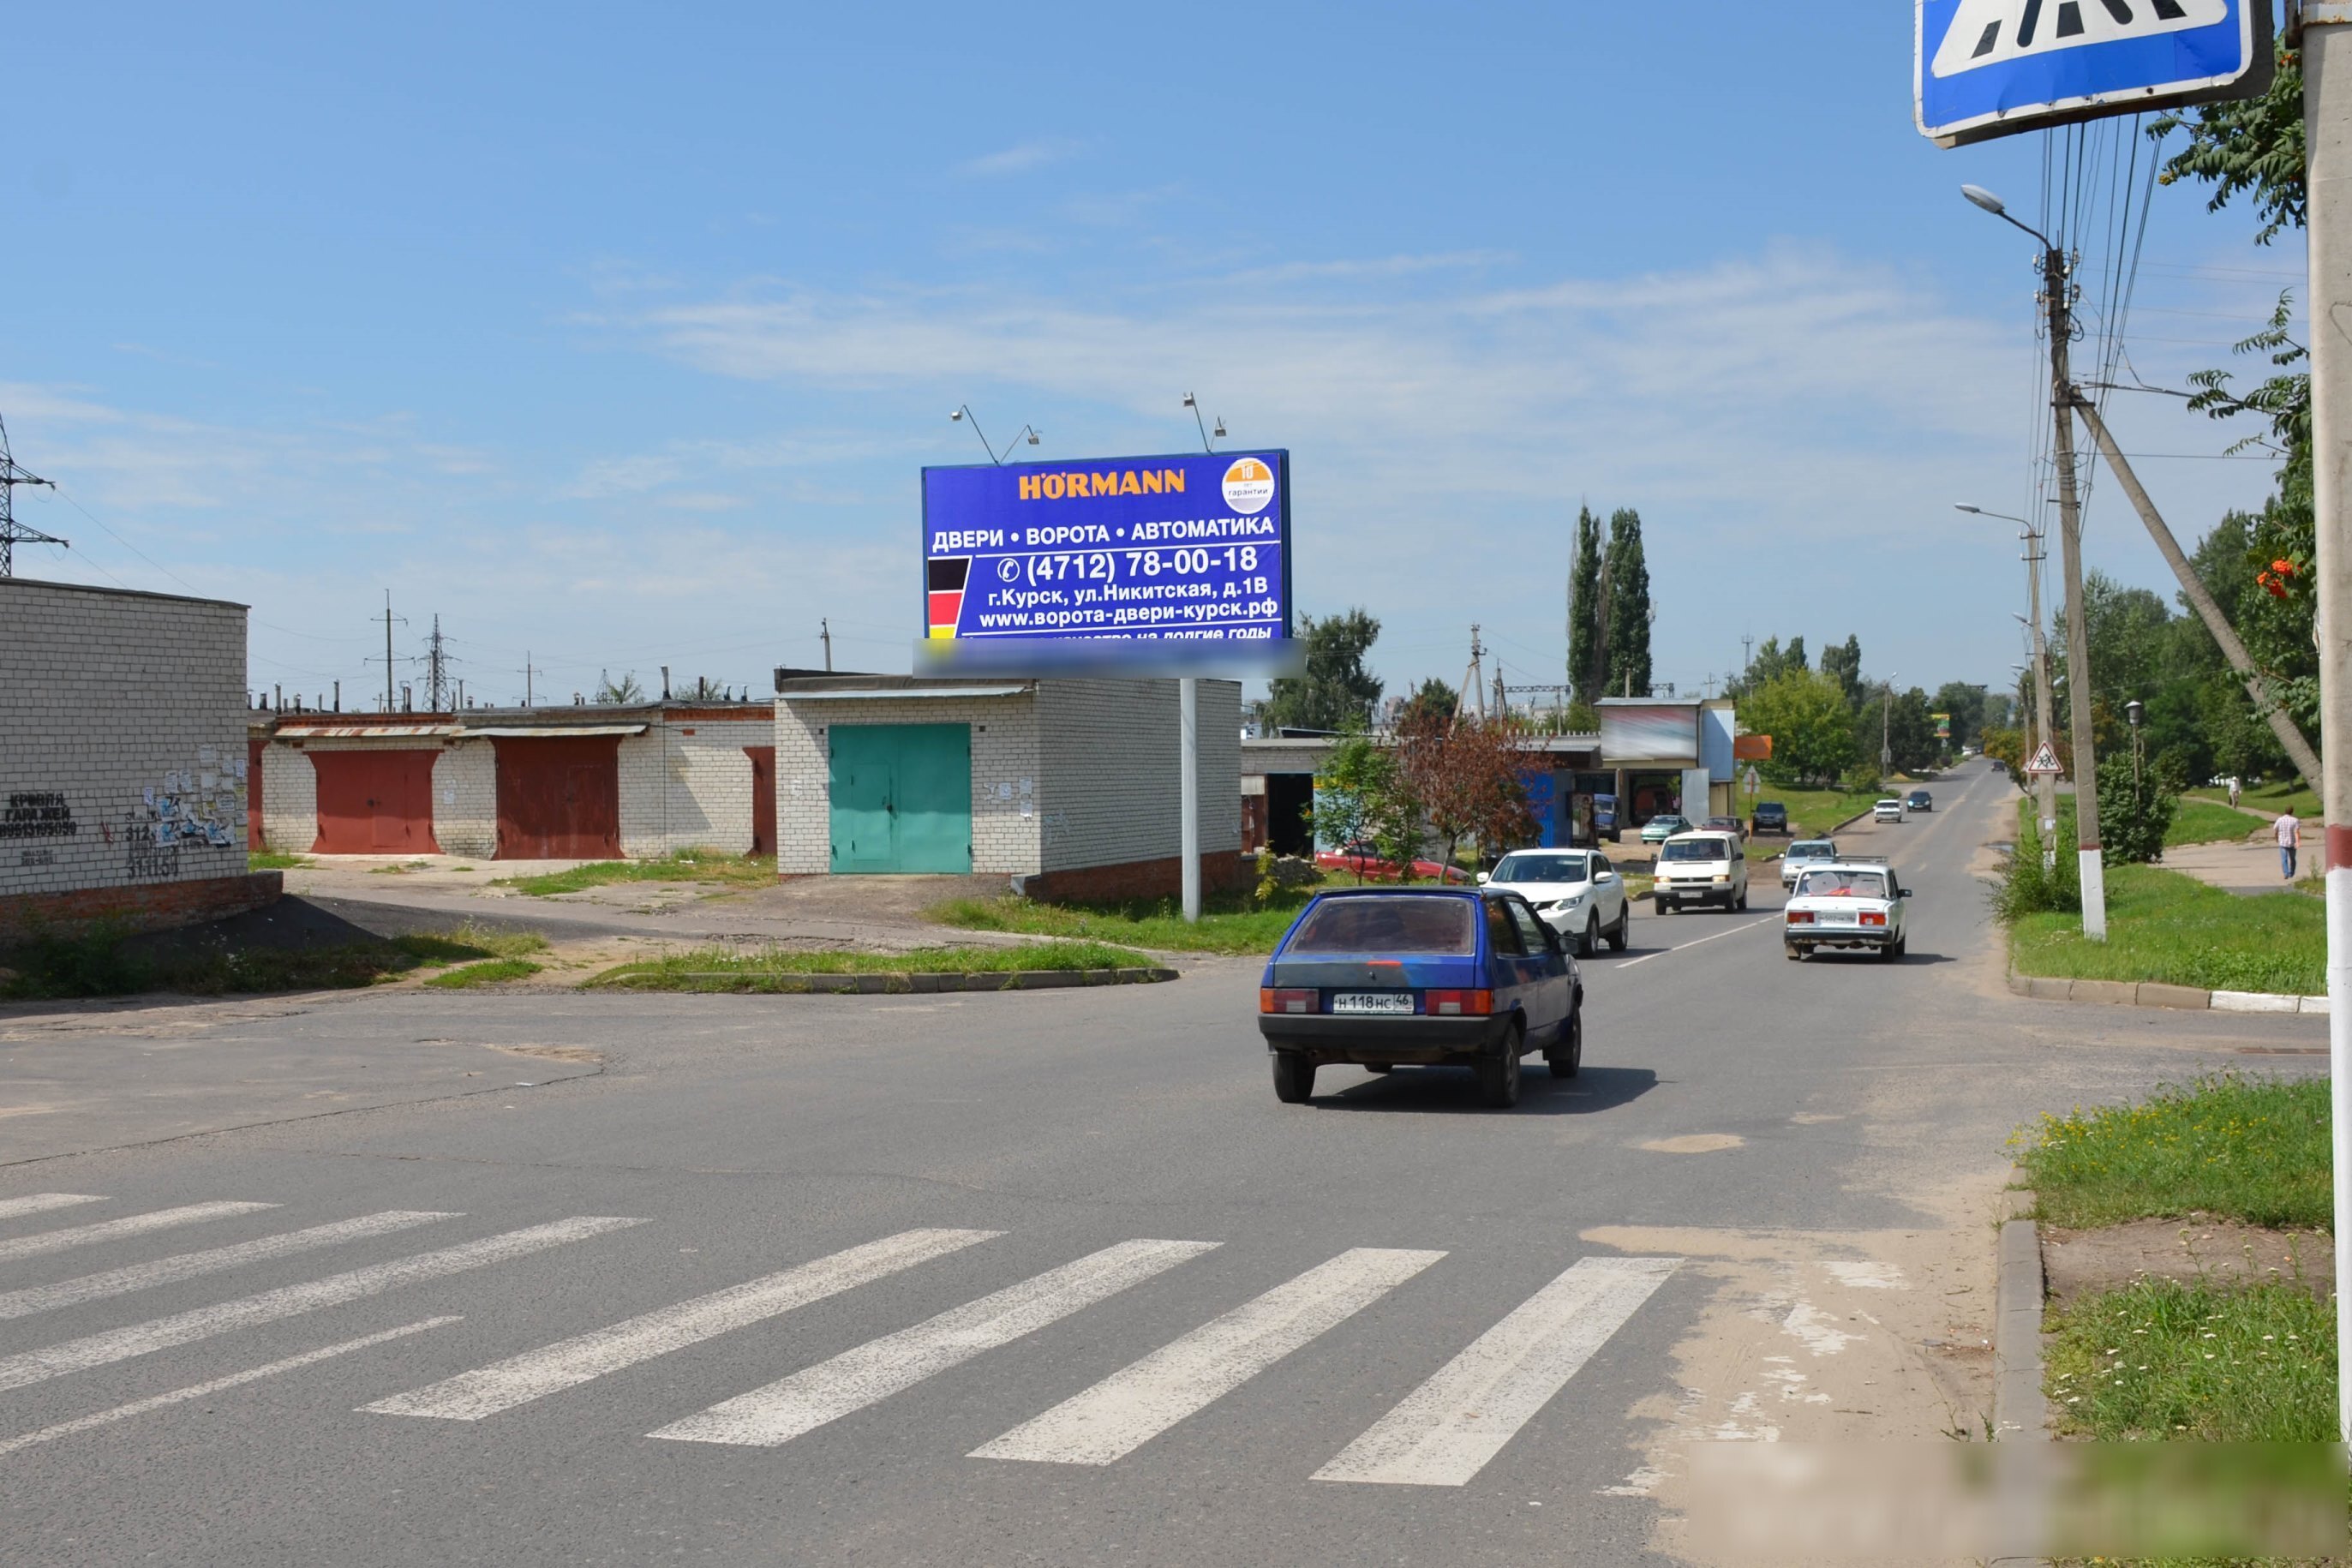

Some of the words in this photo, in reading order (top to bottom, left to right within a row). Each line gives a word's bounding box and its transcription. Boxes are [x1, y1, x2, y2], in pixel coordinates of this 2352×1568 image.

[1019, 469, 1185, 500] HÖRMANN
[1229, 488, 1268, 497] гарантии
[932, 530, 1003, 553] ДВЕРИ
[1026, 524, 1110, 545] ВОРОТА
[1131, 517, 1275, 541] АВТОМАТИКА
[1027, 553, 1116, 586] (4712)
[1126, 546, 1258, 577] 78-00-18
[988, 589, 1068, 608] г.Курск,
[1074, 583, 1218, 606] ул.Никитская,
[1223, 577, 1268, 598] д.1В
[979, 597, 1278, 627] www.ворота-двери-курск.рф
